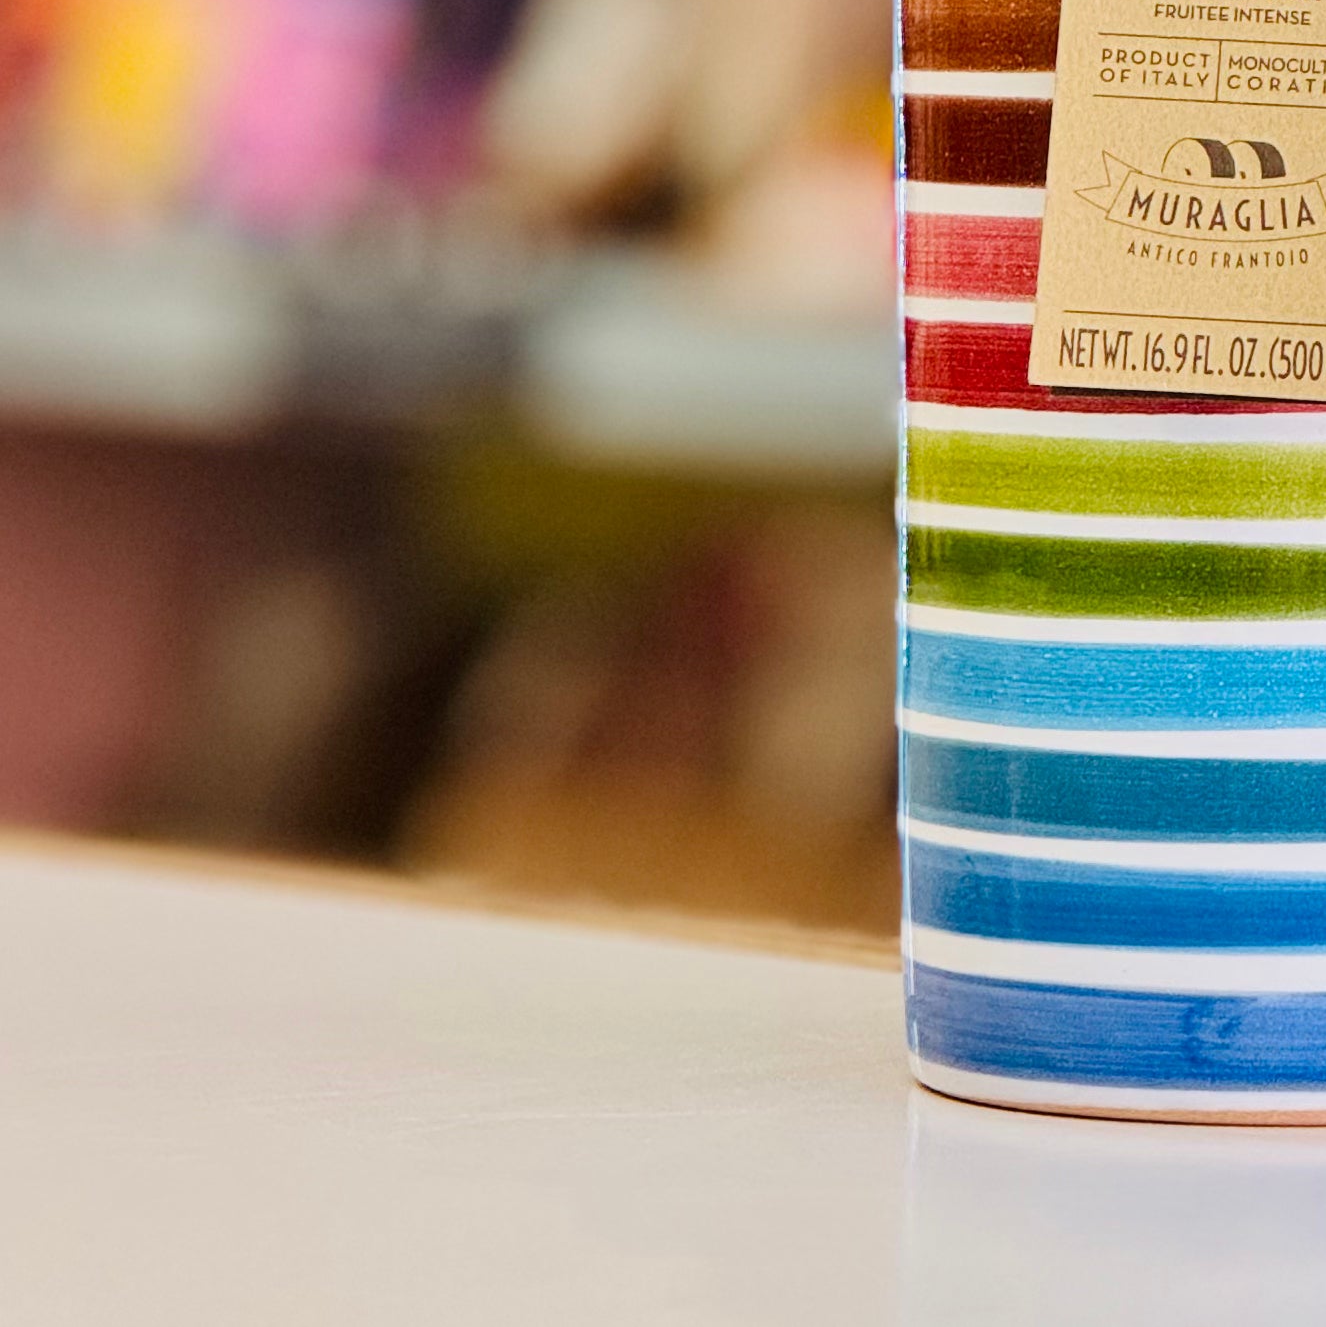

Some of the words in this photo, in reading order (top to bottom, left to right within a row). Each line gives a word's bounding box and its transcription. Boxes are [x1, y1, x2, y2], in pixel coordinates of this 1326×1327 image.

[1154, 3, 1229, 22] FRUITEE
[1234, 7, 1311, 26] INTENSE
[1101, 48, 1212, 69] PRODUCT
[1100, 68, 1131, 85] OF
[1142, 70, 1210, 88] ITALY
[1127, 185, 1316, 233] MURAGLIA
[1127, 241, 1198, 267] ANTICO
[1211, 248, 1308, 269] FRANTOIO
